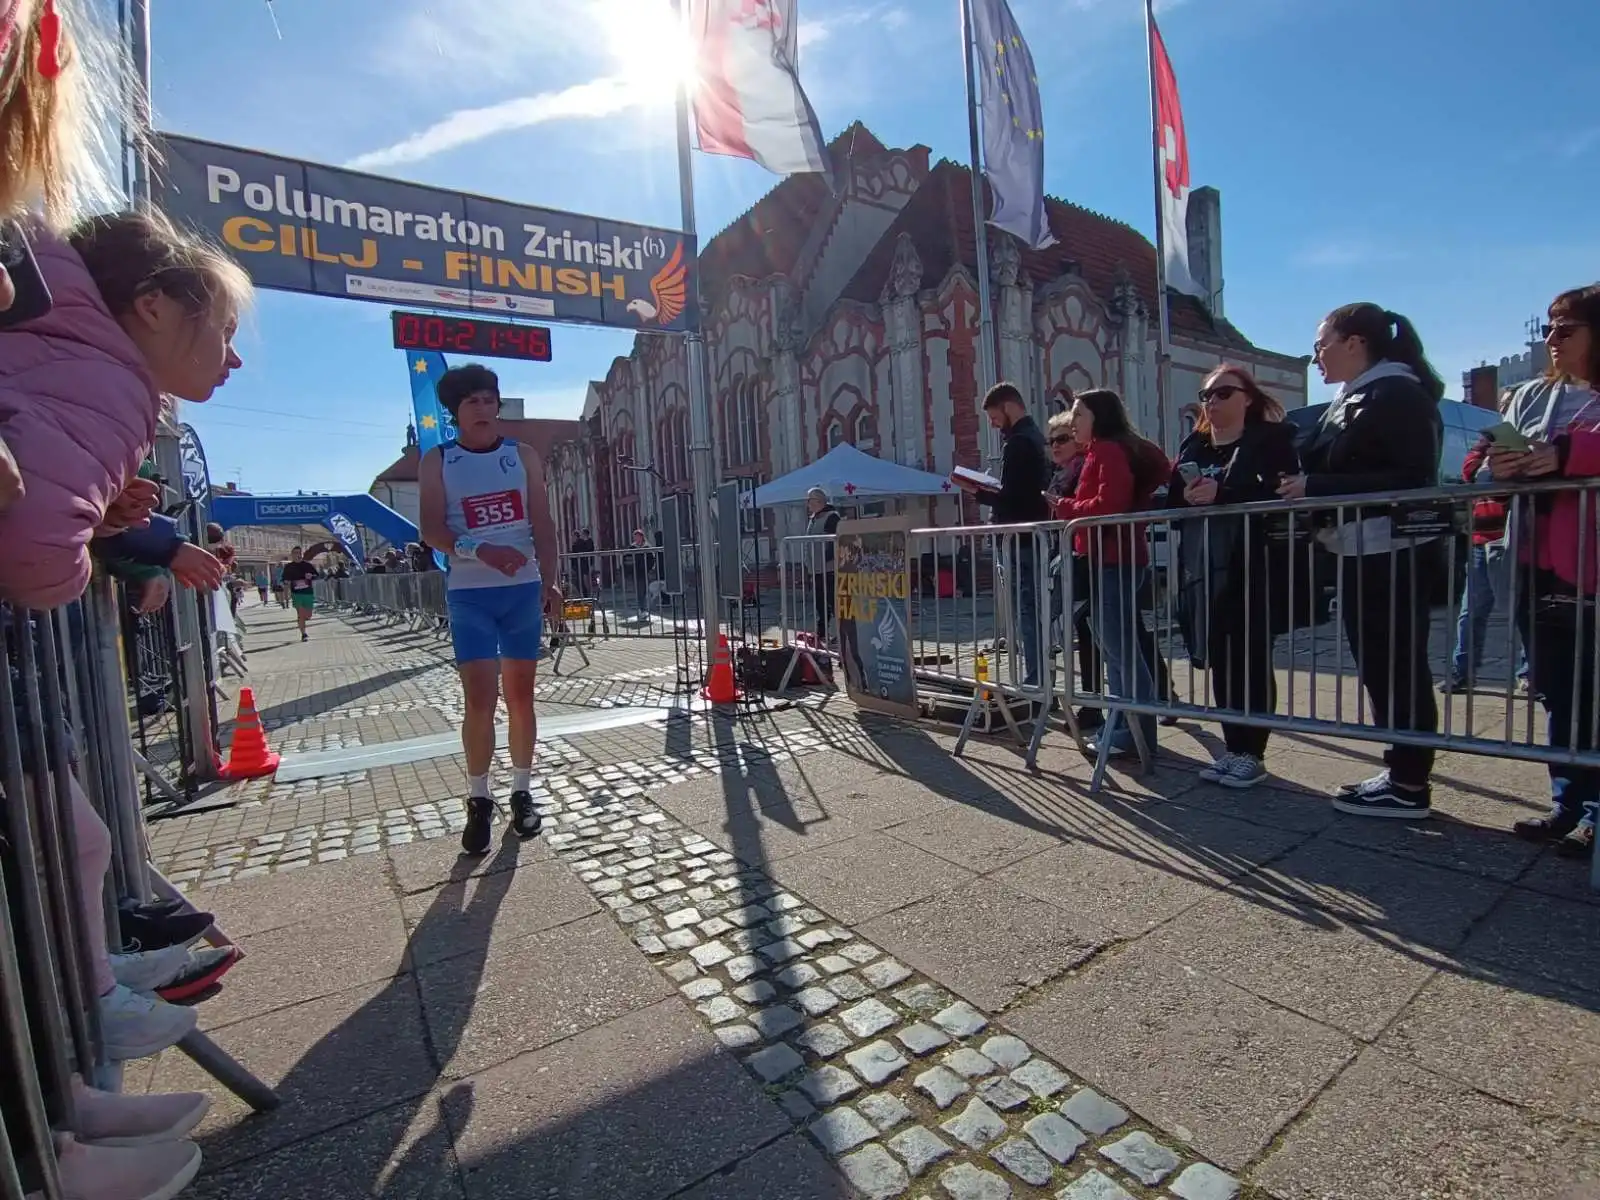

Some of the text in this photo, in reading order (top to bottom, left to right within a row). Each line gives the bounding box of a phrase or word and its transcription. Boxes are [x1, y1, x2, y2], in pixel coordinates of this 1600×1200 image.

[207, 164, 505, 252] Polumaraton
[221, 216, 379, 270] CILJ
[445, 250, 625, 300] FINISH
[260, 503, 328, 515] DECATHLON
[474, 502, 515, 525] 355
[838, 572, 906, 598] ZRINSKI
[837, 596, 878, 622] HALF
